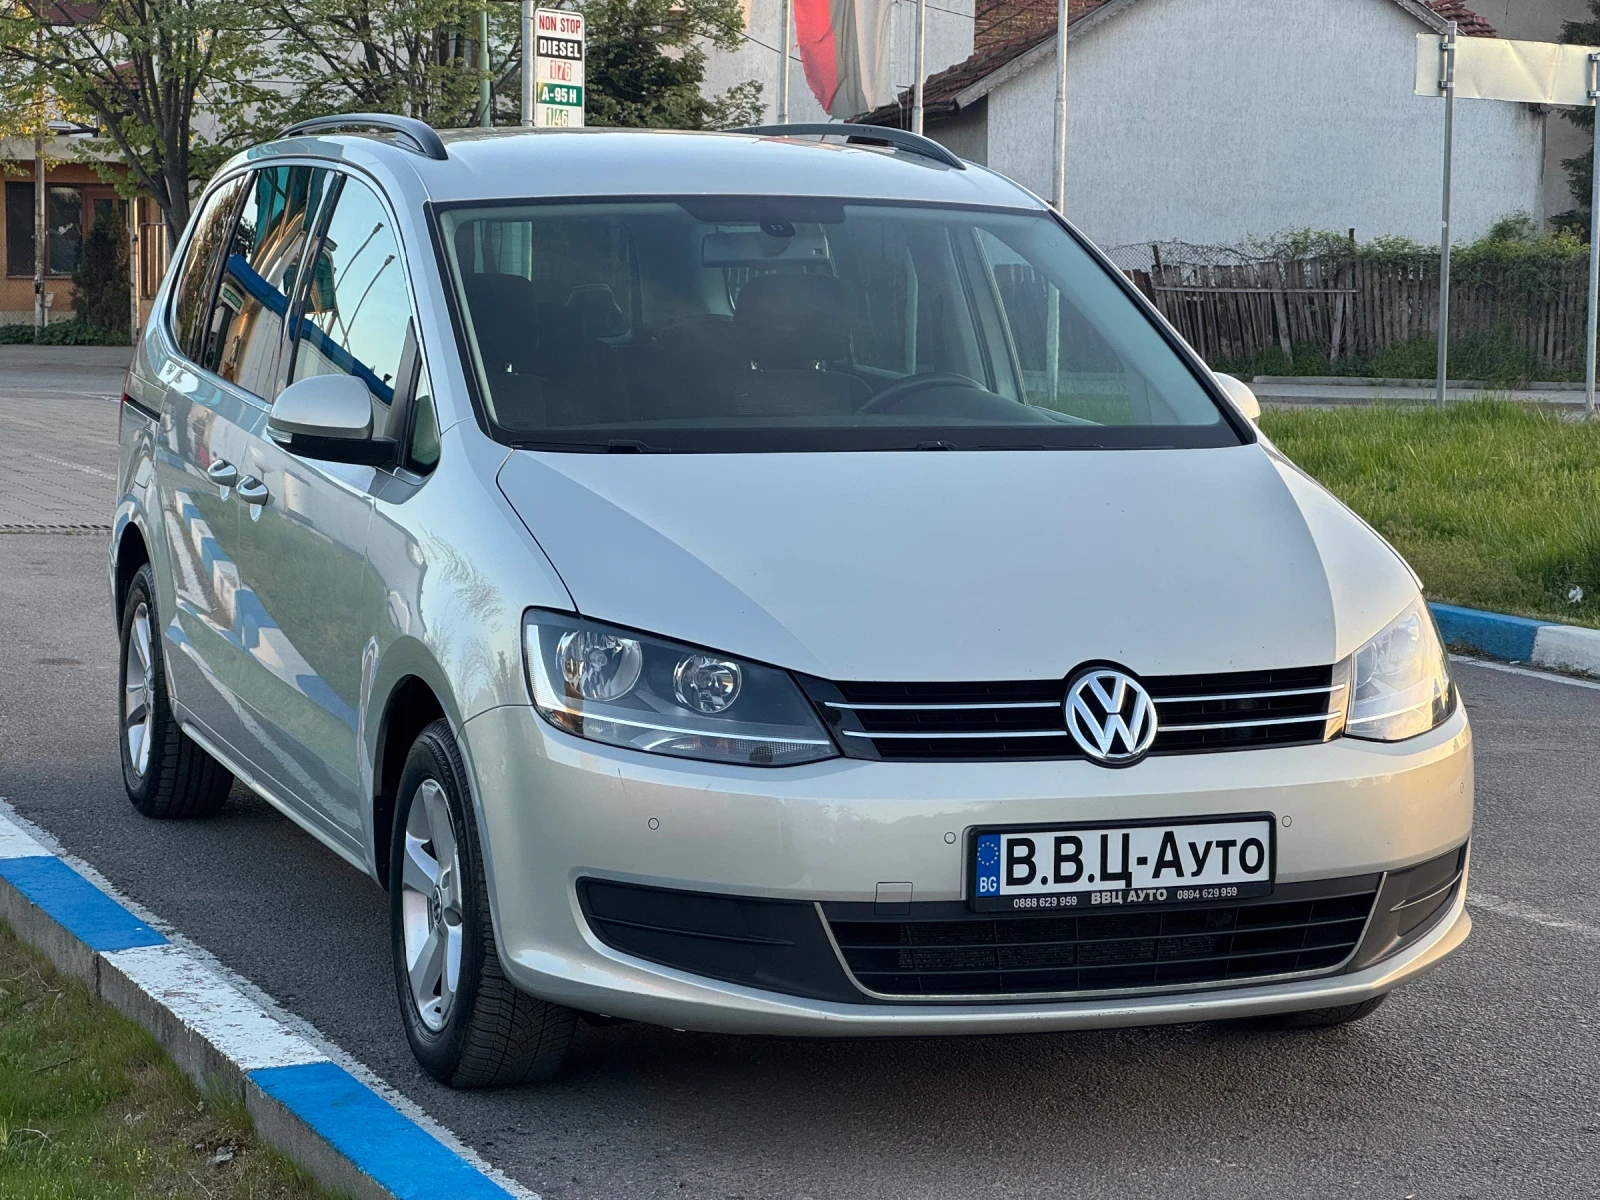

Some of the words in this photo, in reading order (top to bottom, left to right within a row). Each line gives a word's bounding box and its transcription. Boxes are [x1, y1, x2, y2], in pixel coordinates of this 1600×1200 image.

[539, 15, 557, 32] NON
[560, 17, 581, 34] STOP
[539, 39, 580, 58] DIESEL
[550, 60, 571, 81] 176
[979, 876, 998, 893] BG
[1177, 889, 1200, 900] 0894
[1202, 888, 1219, 898] 629
[1220, 886, 1238, 897] 959
[1013, 898, 1038, 908] 0888
[1039, 897, 1058, 907] 629
[1059, 896, 1078, 906] 959
[1091, 891, 1123, 905] ВВЦ
[1127, 889, 1168, 903] АУТО
